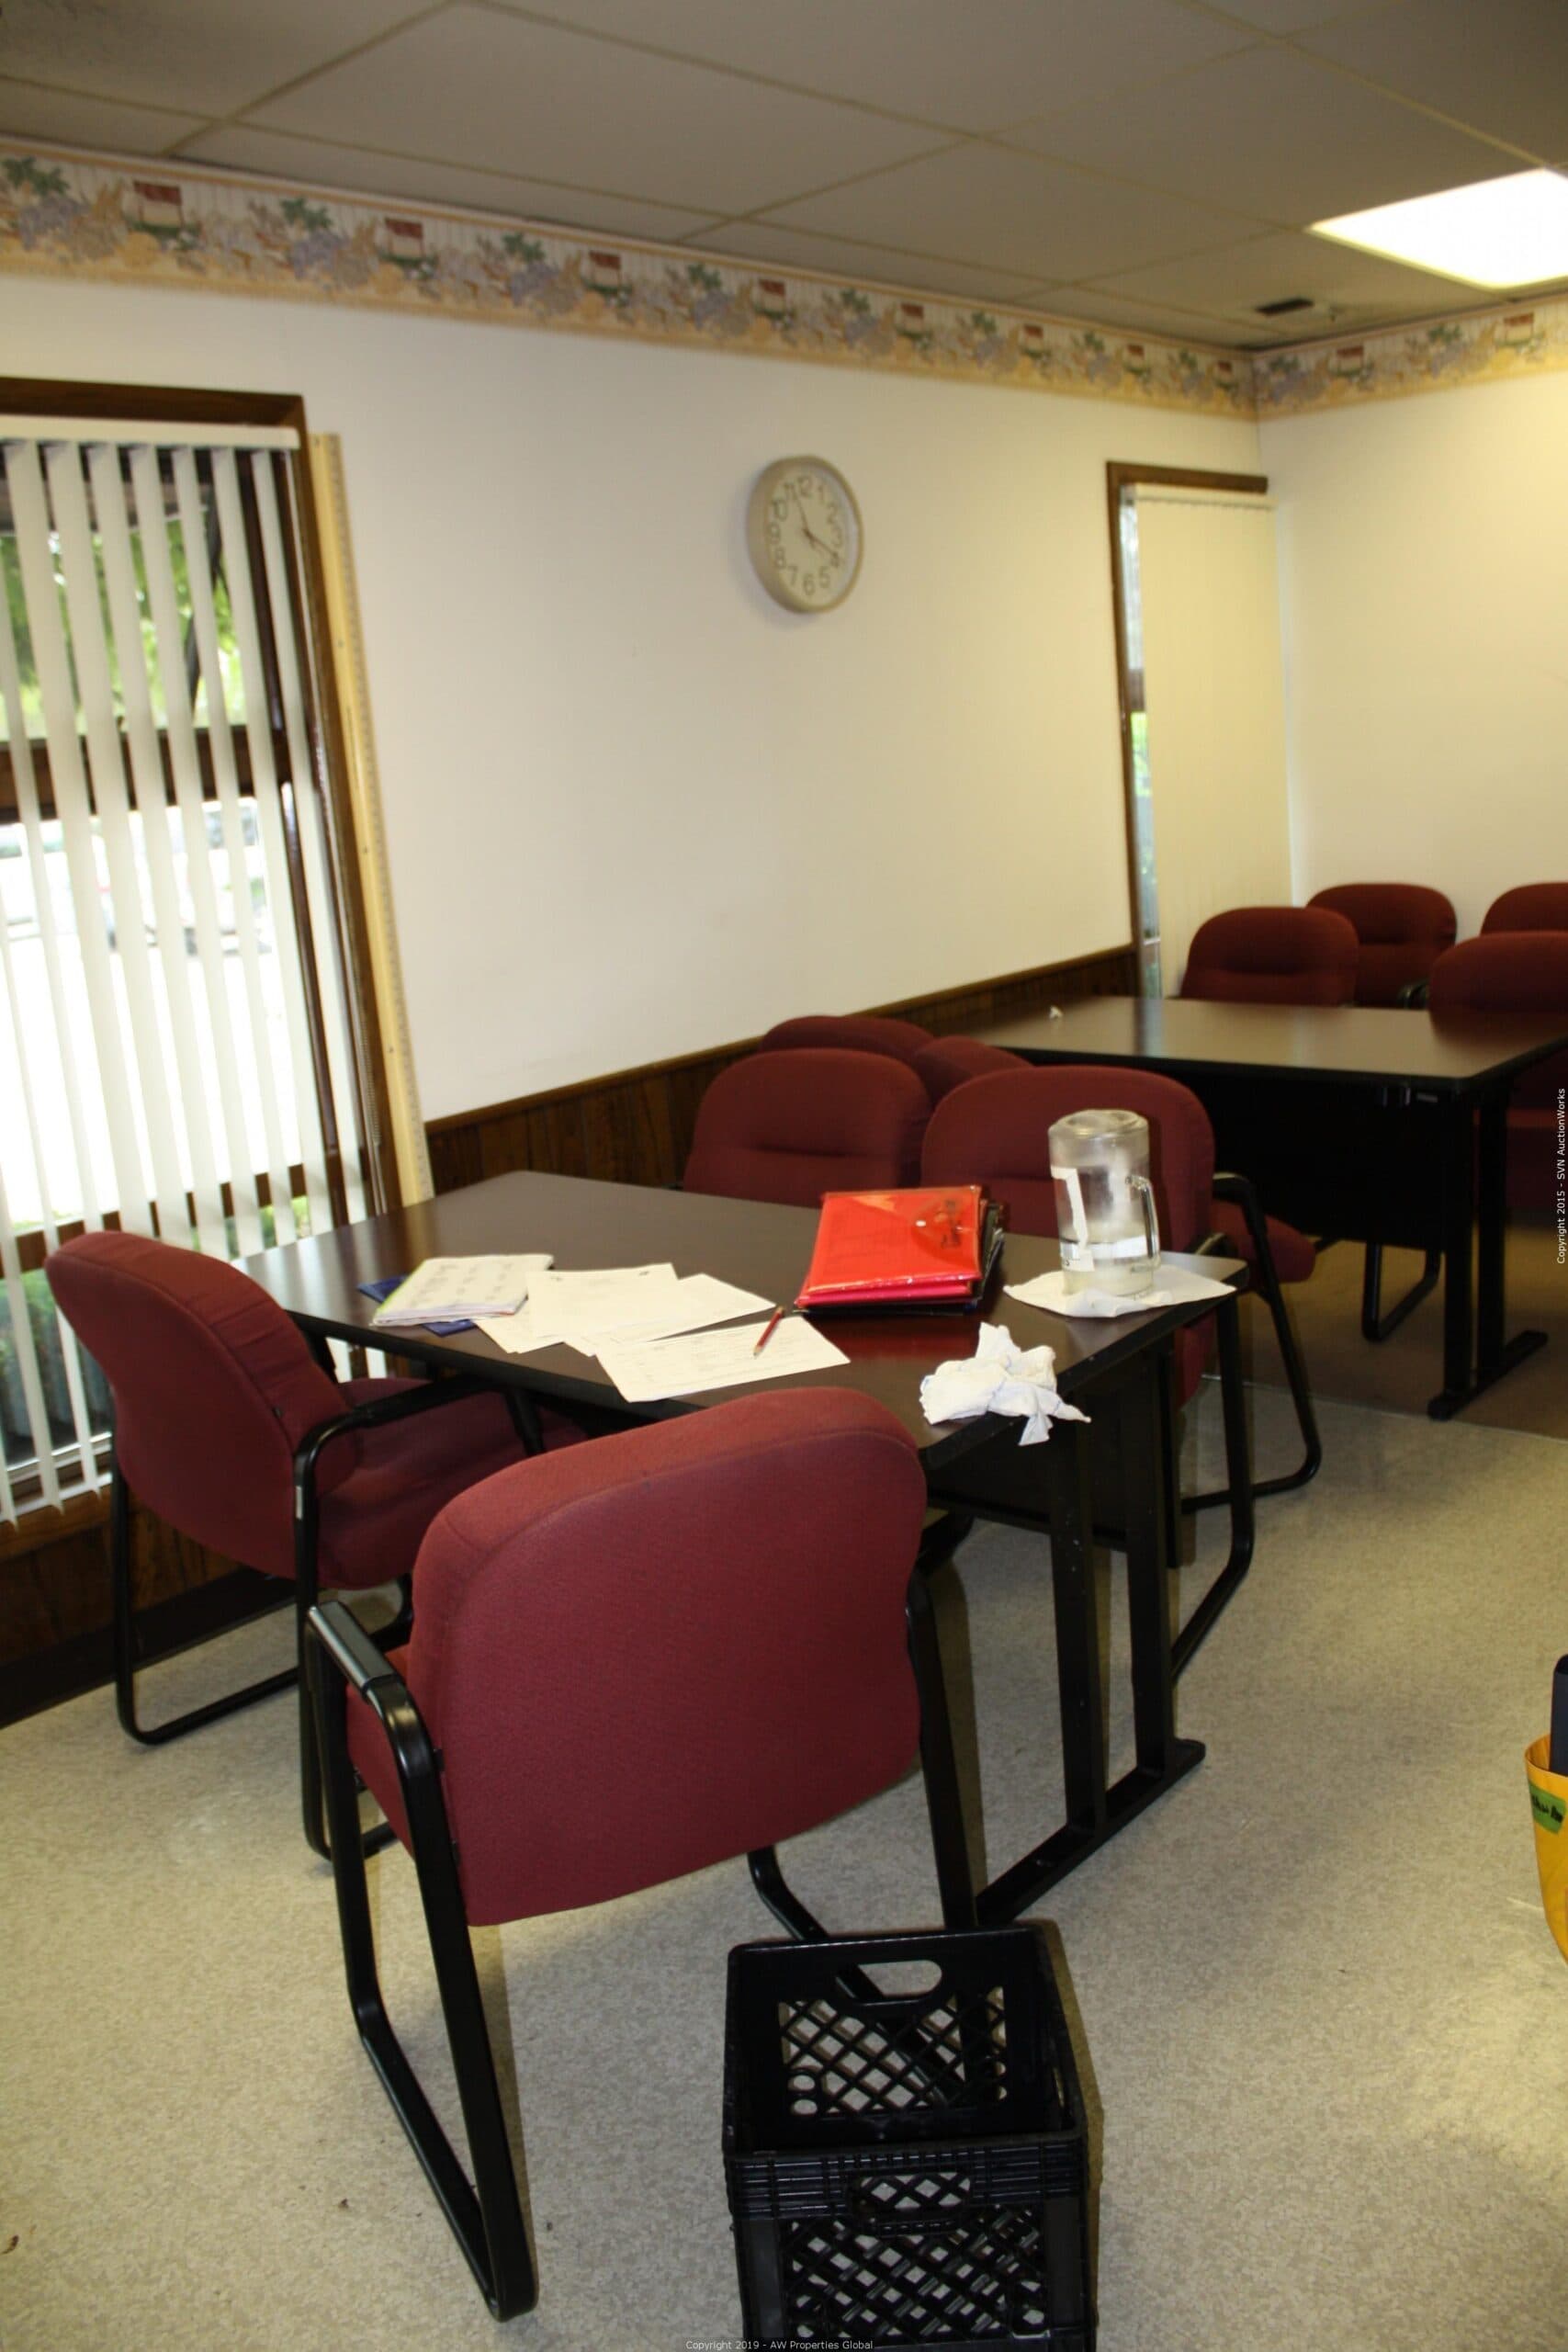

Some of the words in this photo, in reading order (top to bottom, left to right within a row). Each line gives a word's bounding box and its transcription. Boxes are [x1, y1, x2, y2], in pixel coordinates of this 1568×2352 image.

[796, 474, 813, 498] 12
[772, 498, 788, 522] 10
[827, 502, 838, 525] 2
[768, 521, 781, 543] 9
[831, 525, 843, 548] 3
[774, 547, 787, 570] 8
[787, 564, 798, 587] 7
[802, 572, 816, 596] 6
[818, 565, 831, 589] 5
